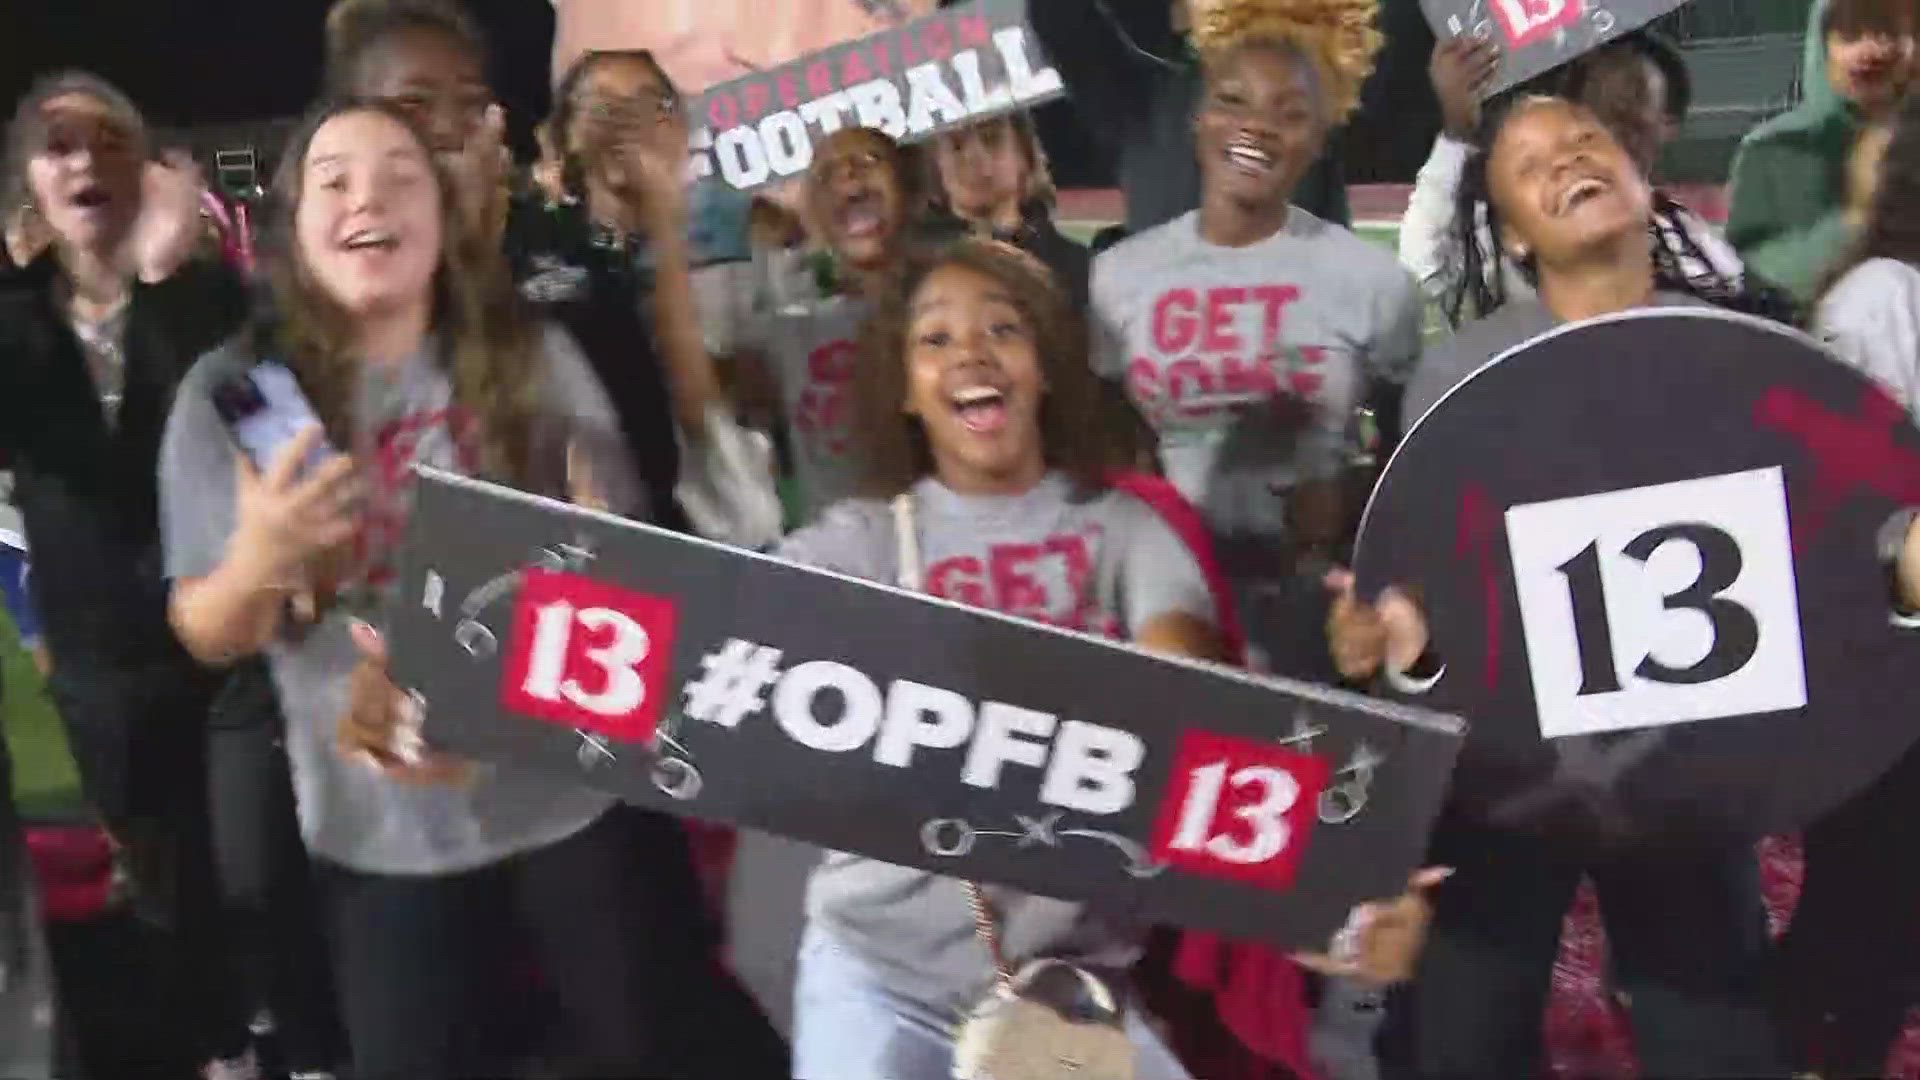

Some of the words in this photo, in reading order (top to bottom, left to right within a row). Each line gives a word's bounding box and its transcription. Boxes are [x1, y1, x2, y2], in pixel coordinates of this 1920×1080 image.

[708, 13, 990, 128] OPERATION
[1153, 284, 1302, 353] GET
[520, 599, 650, 715] 13
[1555, 521, 1759, 696] 13
[683, 637, 1147, 815] #OPFB
[1167, 755, 1300, 864] 13
